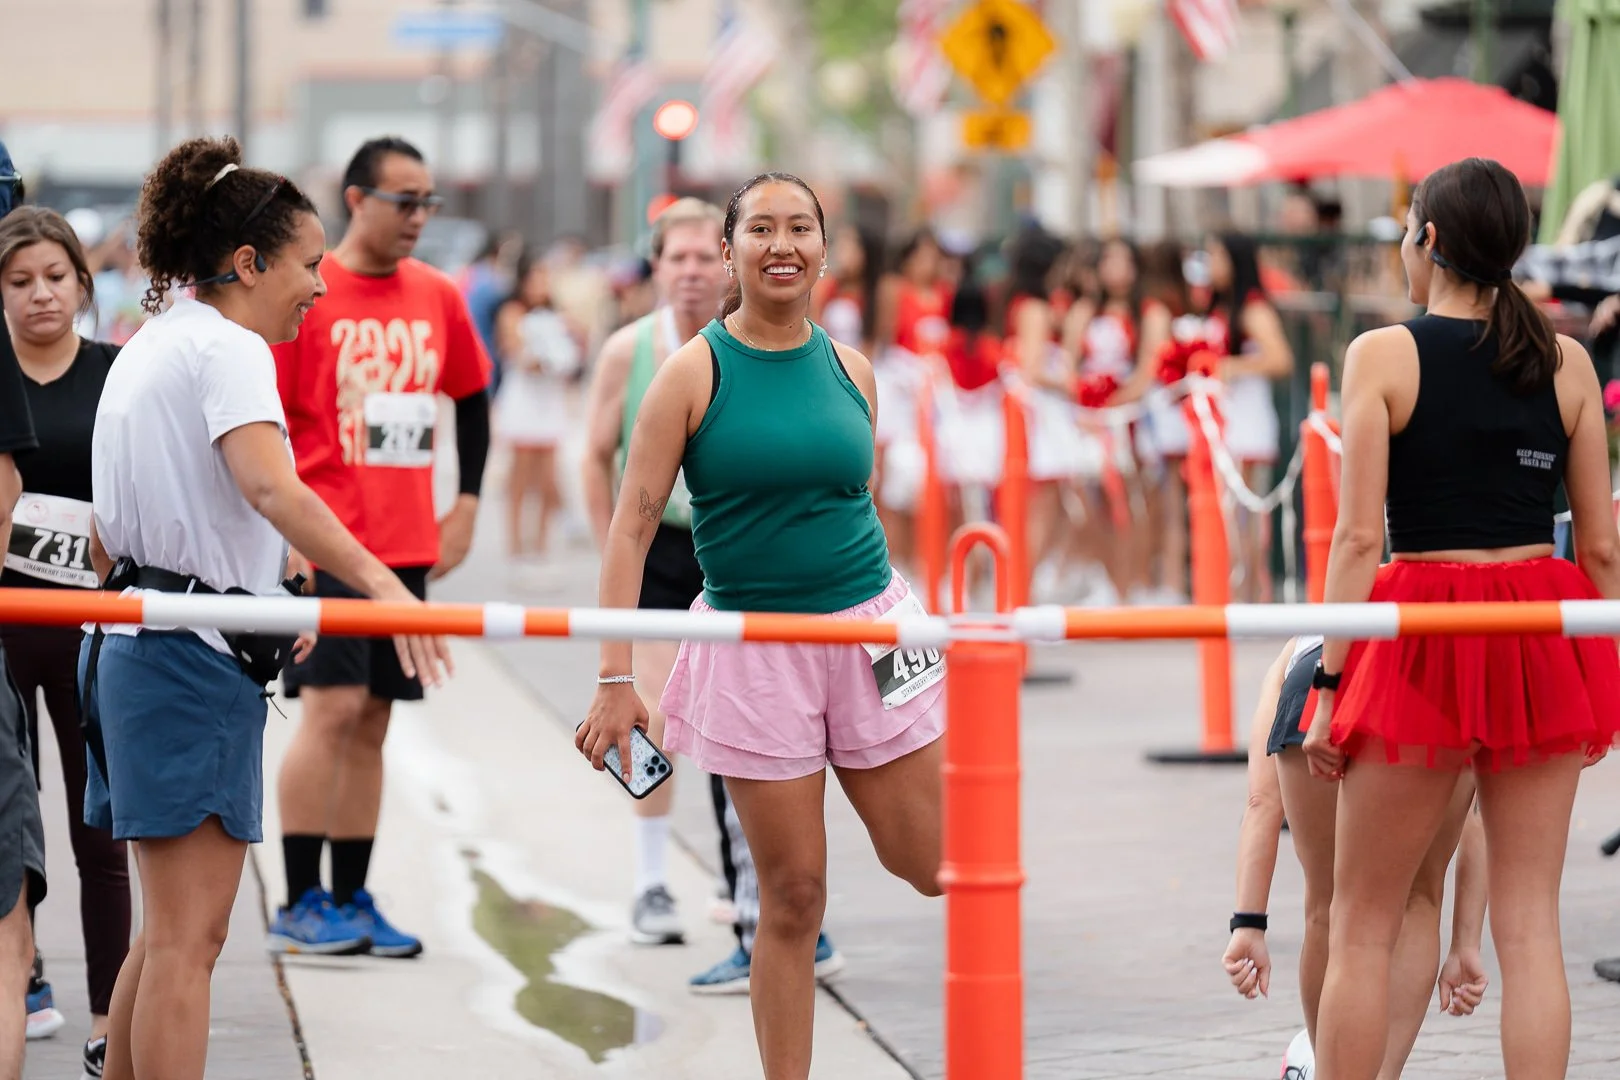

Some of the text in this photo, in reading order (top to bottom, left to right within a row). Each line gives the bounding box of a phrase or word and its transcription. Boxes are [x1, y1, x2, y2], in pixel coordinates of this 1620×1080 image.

[1520, 457, 1539, 467] SANTA
[28, 528, 87, 569] 731
[23, 562, 59, 576] STRAWBERRY
[60, 570, 77, 579] STOMP
[901, 675, 928, 697] STRAWBERRY
